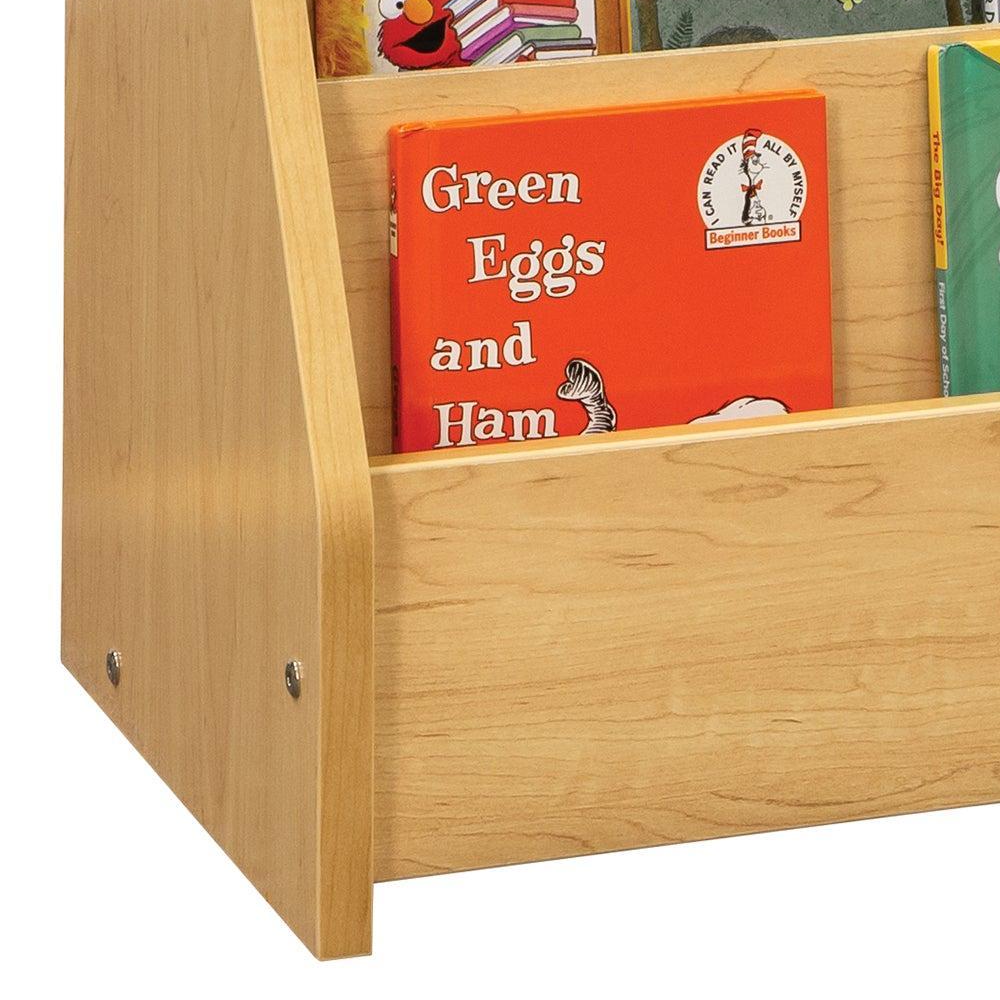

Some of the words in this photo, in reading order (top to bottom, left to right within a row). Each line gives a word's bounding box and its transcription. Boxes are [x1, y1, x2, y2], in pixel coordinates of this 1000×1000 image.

[726, 143, 738, 155] IT
[763, 140, 782, 156] ALL
[783, 153, 797, 168] BY
[932, 131, 941, 163] The
[703, 153, 726, 185] READ
[934, 169, 943, 198] Big
[422, 163, 582, 213] Green
[789, 170, 804, 218] MYSELF
[702, 191, 715, 217] CAN
[709, 230, 759, 246] Beginner
[762, 226, 797, 239] Books
[711, 218, 720, 226] I
[467, 233, 606, 303] Eggs
[938, 281, 946, 310] First
[939, 314, 948, 342] Day
[430, 320, 537, 372] and
[941, 346, 949, 361] of
[433, 400, 558, 449] Ham
